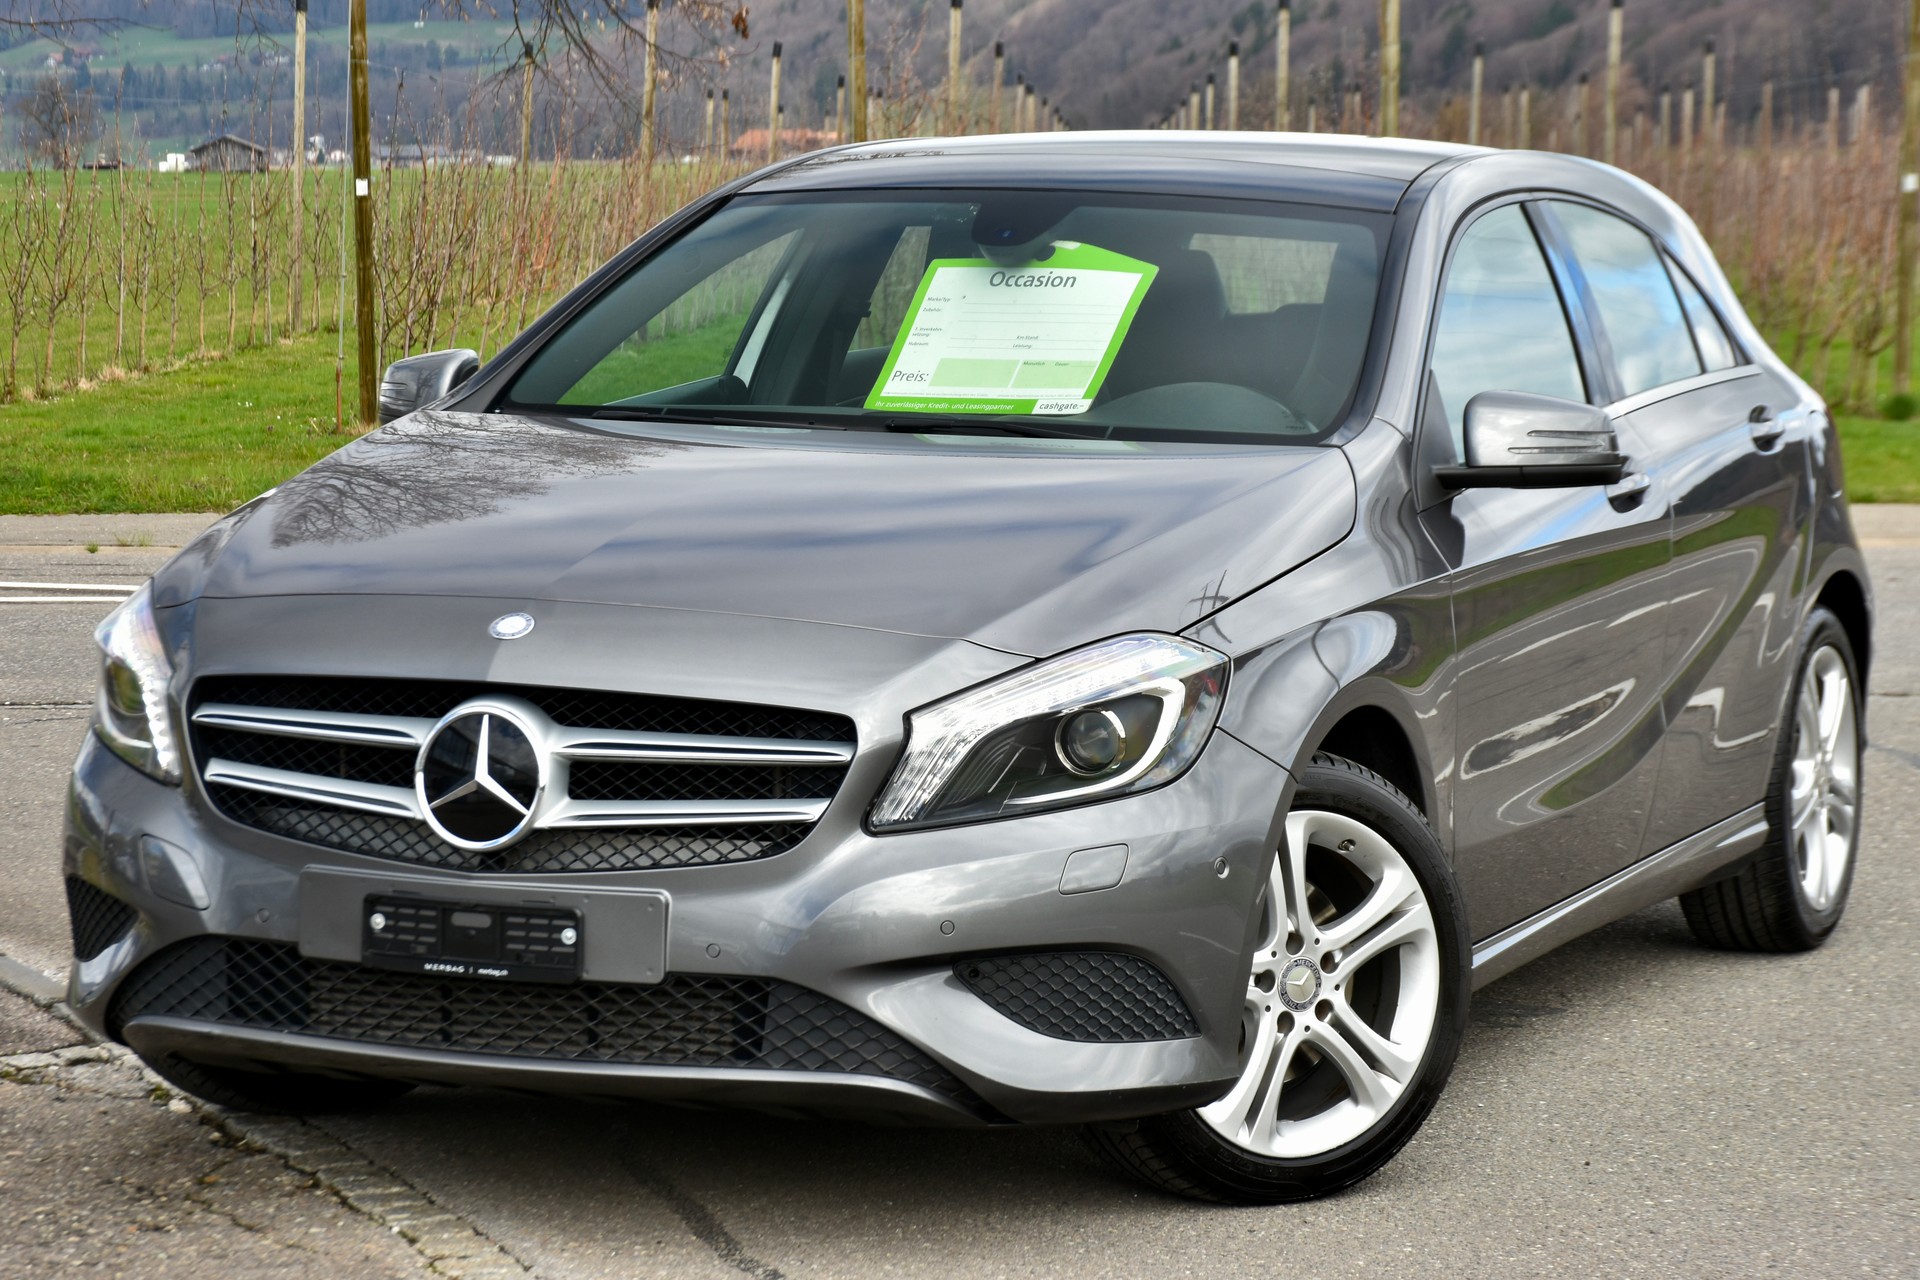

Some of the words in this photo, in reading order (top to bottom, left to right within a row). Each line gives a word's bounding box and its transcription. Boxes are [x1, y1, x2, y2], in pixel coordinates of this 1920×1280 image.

[989, 271, 1077, 288] Occasion
[891, 370, 929, 382] Preis:
[885, 402, 927, 410] zuverlässiger
[965, 403, 1014, 411] Leasingpartner
[424, 963, 465, 973] MERBAG
